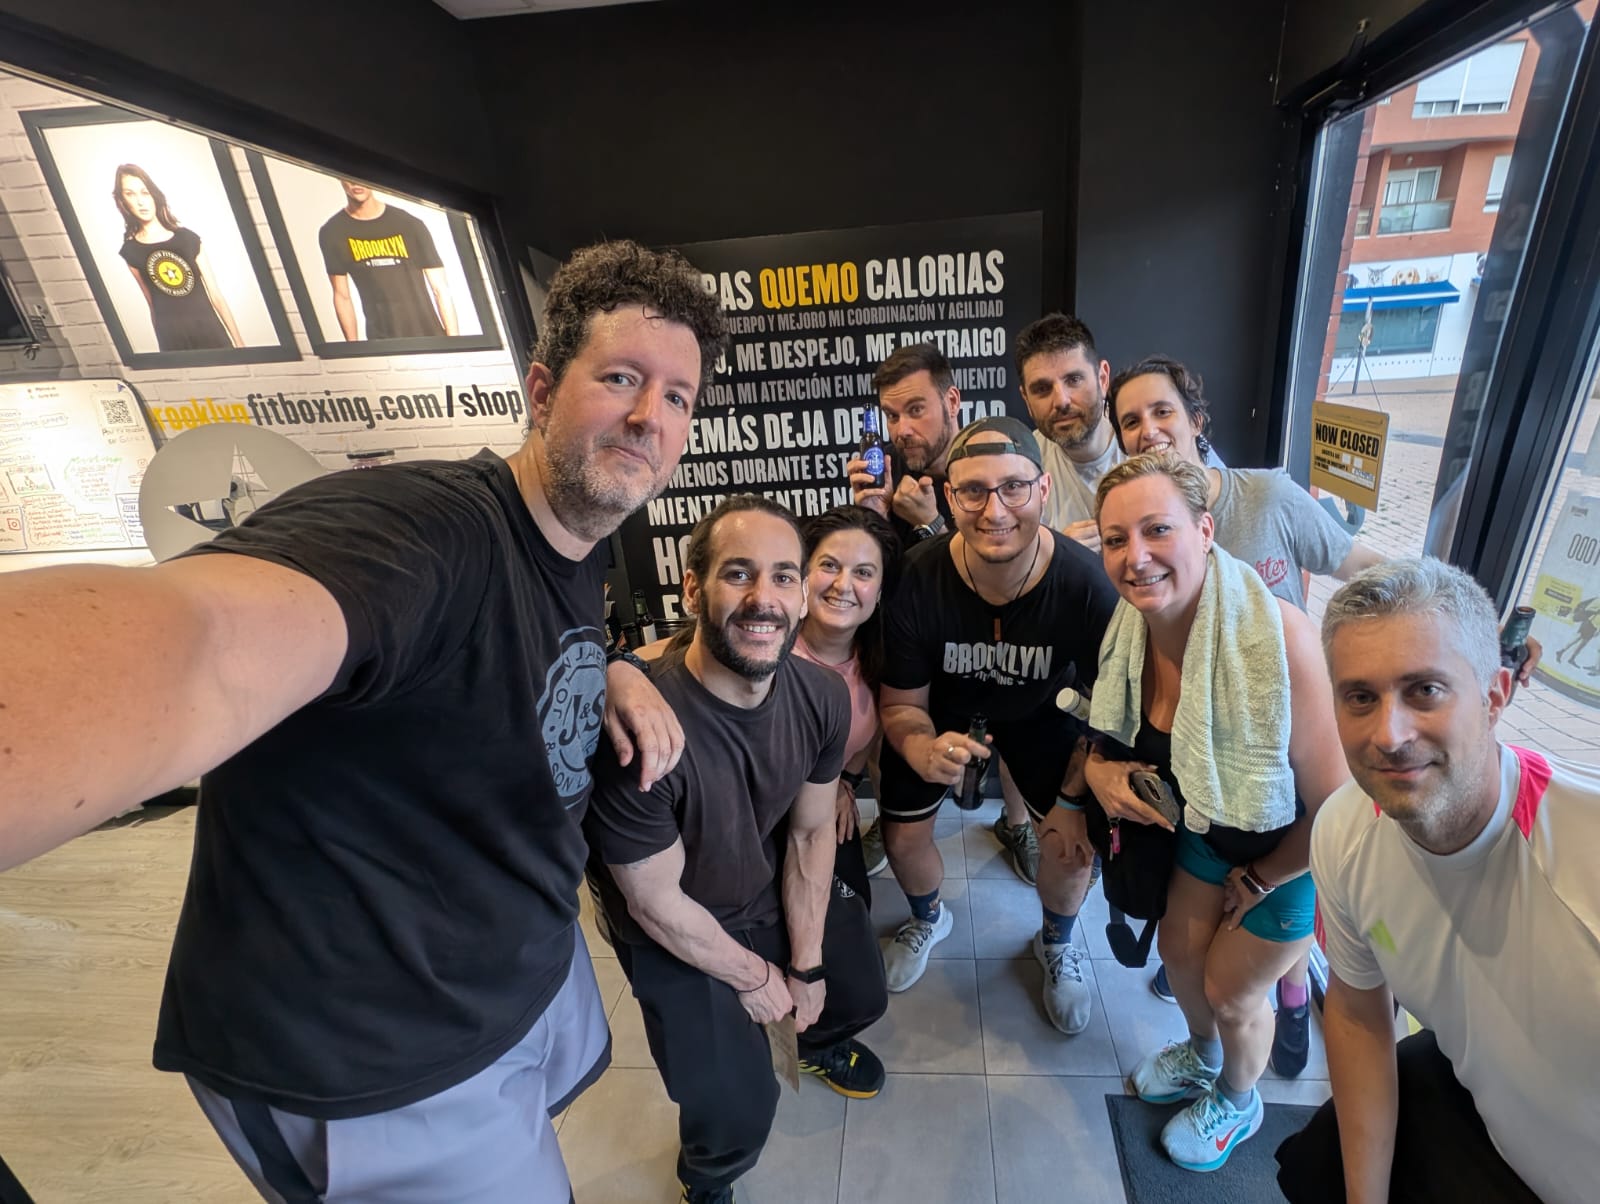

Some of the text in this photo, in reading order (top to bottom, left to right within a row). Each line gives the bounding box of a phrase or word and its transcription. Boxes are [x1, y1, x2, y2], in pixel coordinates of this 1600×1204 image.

[348, 234, 409, 262] BROOKLYN
[759, 262, 859, 310] QUEMO
[866, 249, 1004, 301] CALORIAS
[768, 314, 776, 333] Y
[778, 310, 827, 332] MEJORO
[829, 309, 845, 328] MI
[847, 300, 935, 327] COORDINACIÓN
[937, 303, 945, 321] Y
[948, 300, 1004, 320] AGILIDAD
[736, 342, 767, 373] ME
[769, 335, 860, 371] DESPEJO,
[737, 381, 758, 404] MI
[760, 372, 832, 403] ATENCIÓN
[834, 374, 854, 398] EN
[680, 407, 759, 456] EMÁS
[763, 409, 829, 450] DEJA
[833, 406, 864, 445] DE
[1315, 422, 1380, 458] NOW CLOSED
[668, 461, 729, 489] MENOS
[731, 453, 812, 485] DURANTE
[647, 493, 754, 526] MIENT
[943, 641, 1053, 680] BROOKLYN
